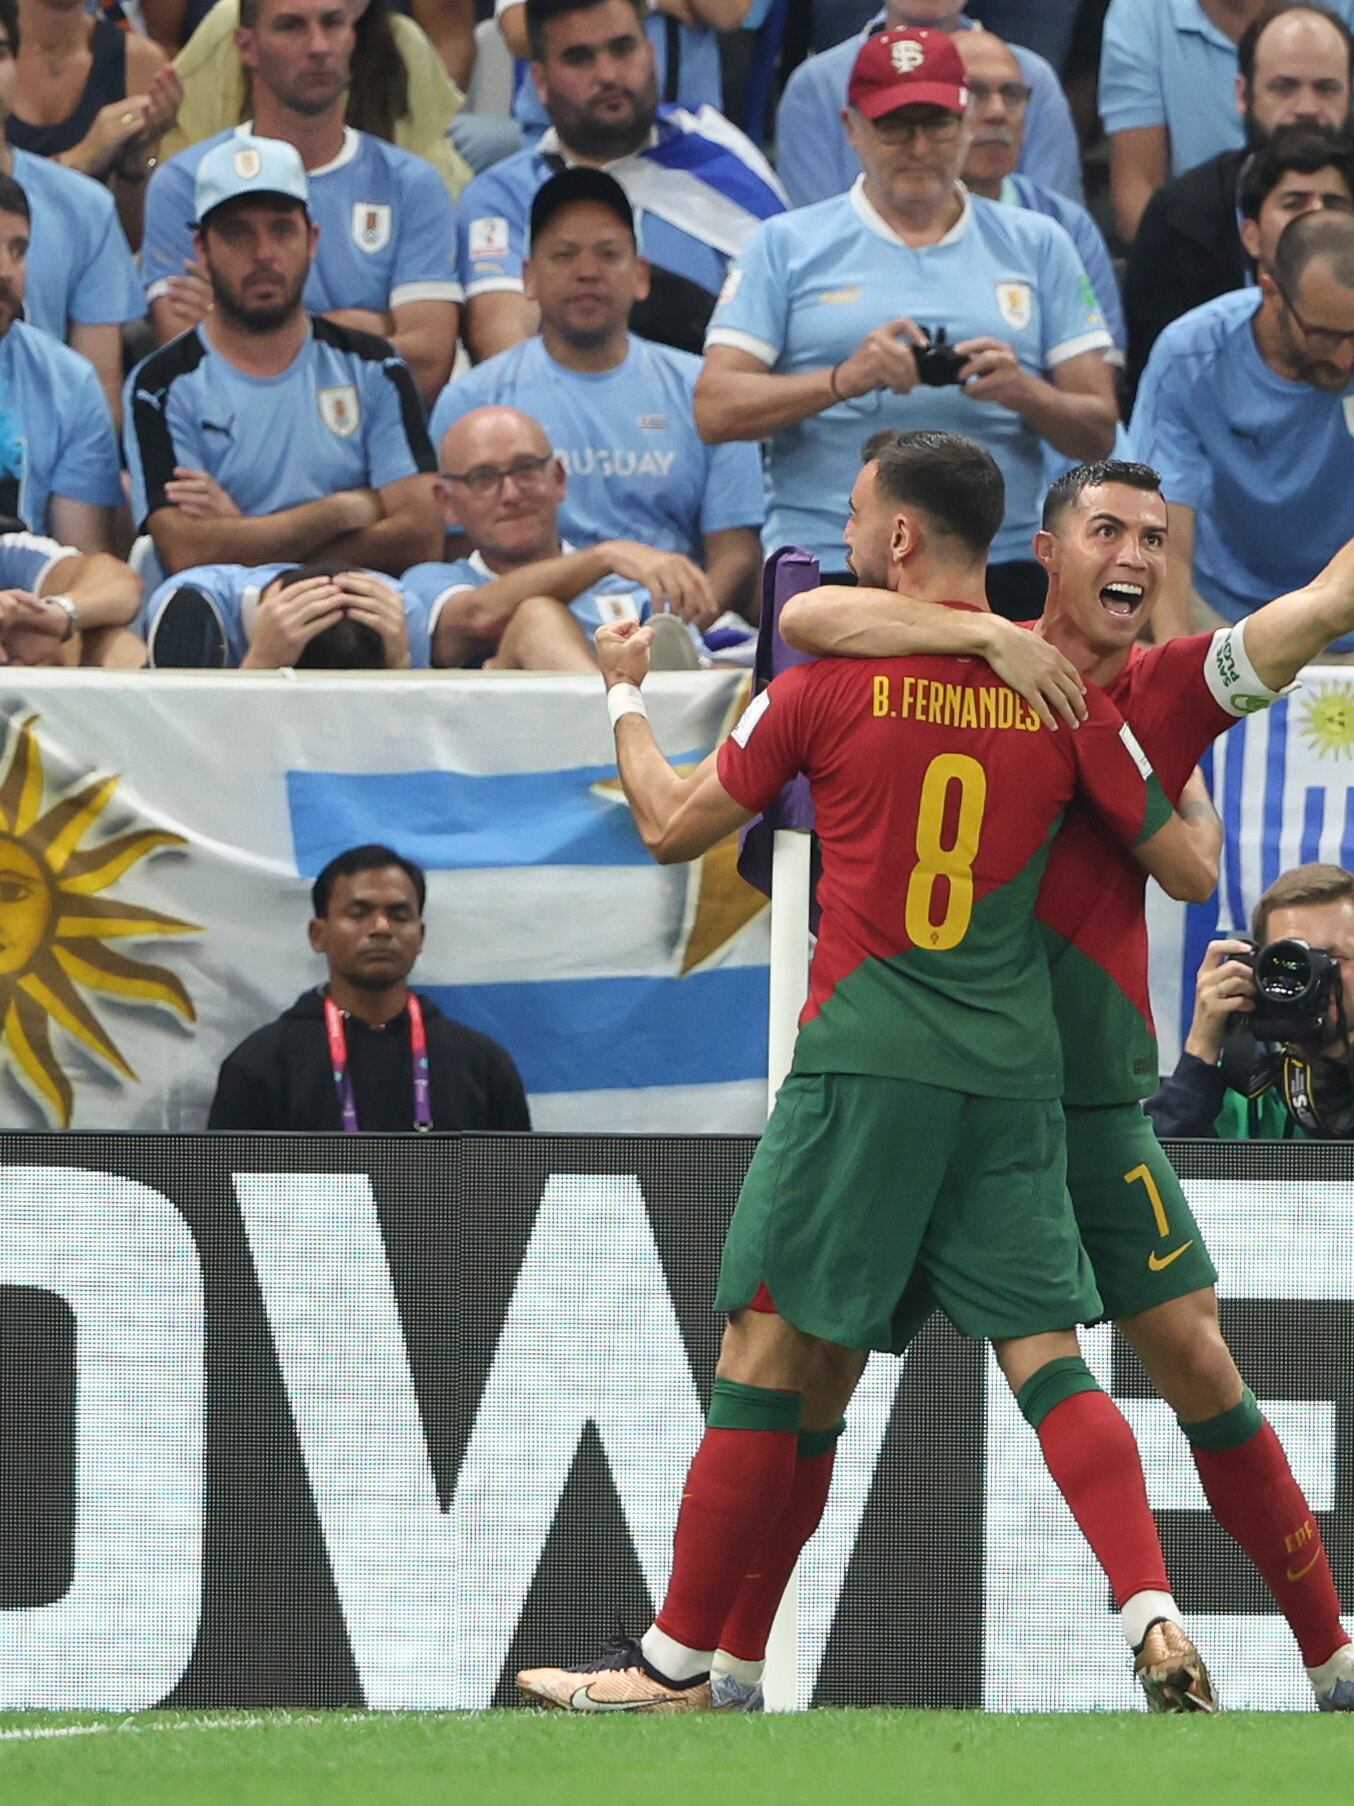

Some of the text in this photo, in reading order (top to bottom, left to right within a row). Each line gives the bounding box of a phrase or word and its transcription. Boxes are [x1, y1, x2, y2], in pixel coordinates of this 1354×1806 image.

[872, 675, 1041, 732] B. FERNANDES
[905, 752, 987, 951] 8
[1123, 1163, 1170, 1238] 7
